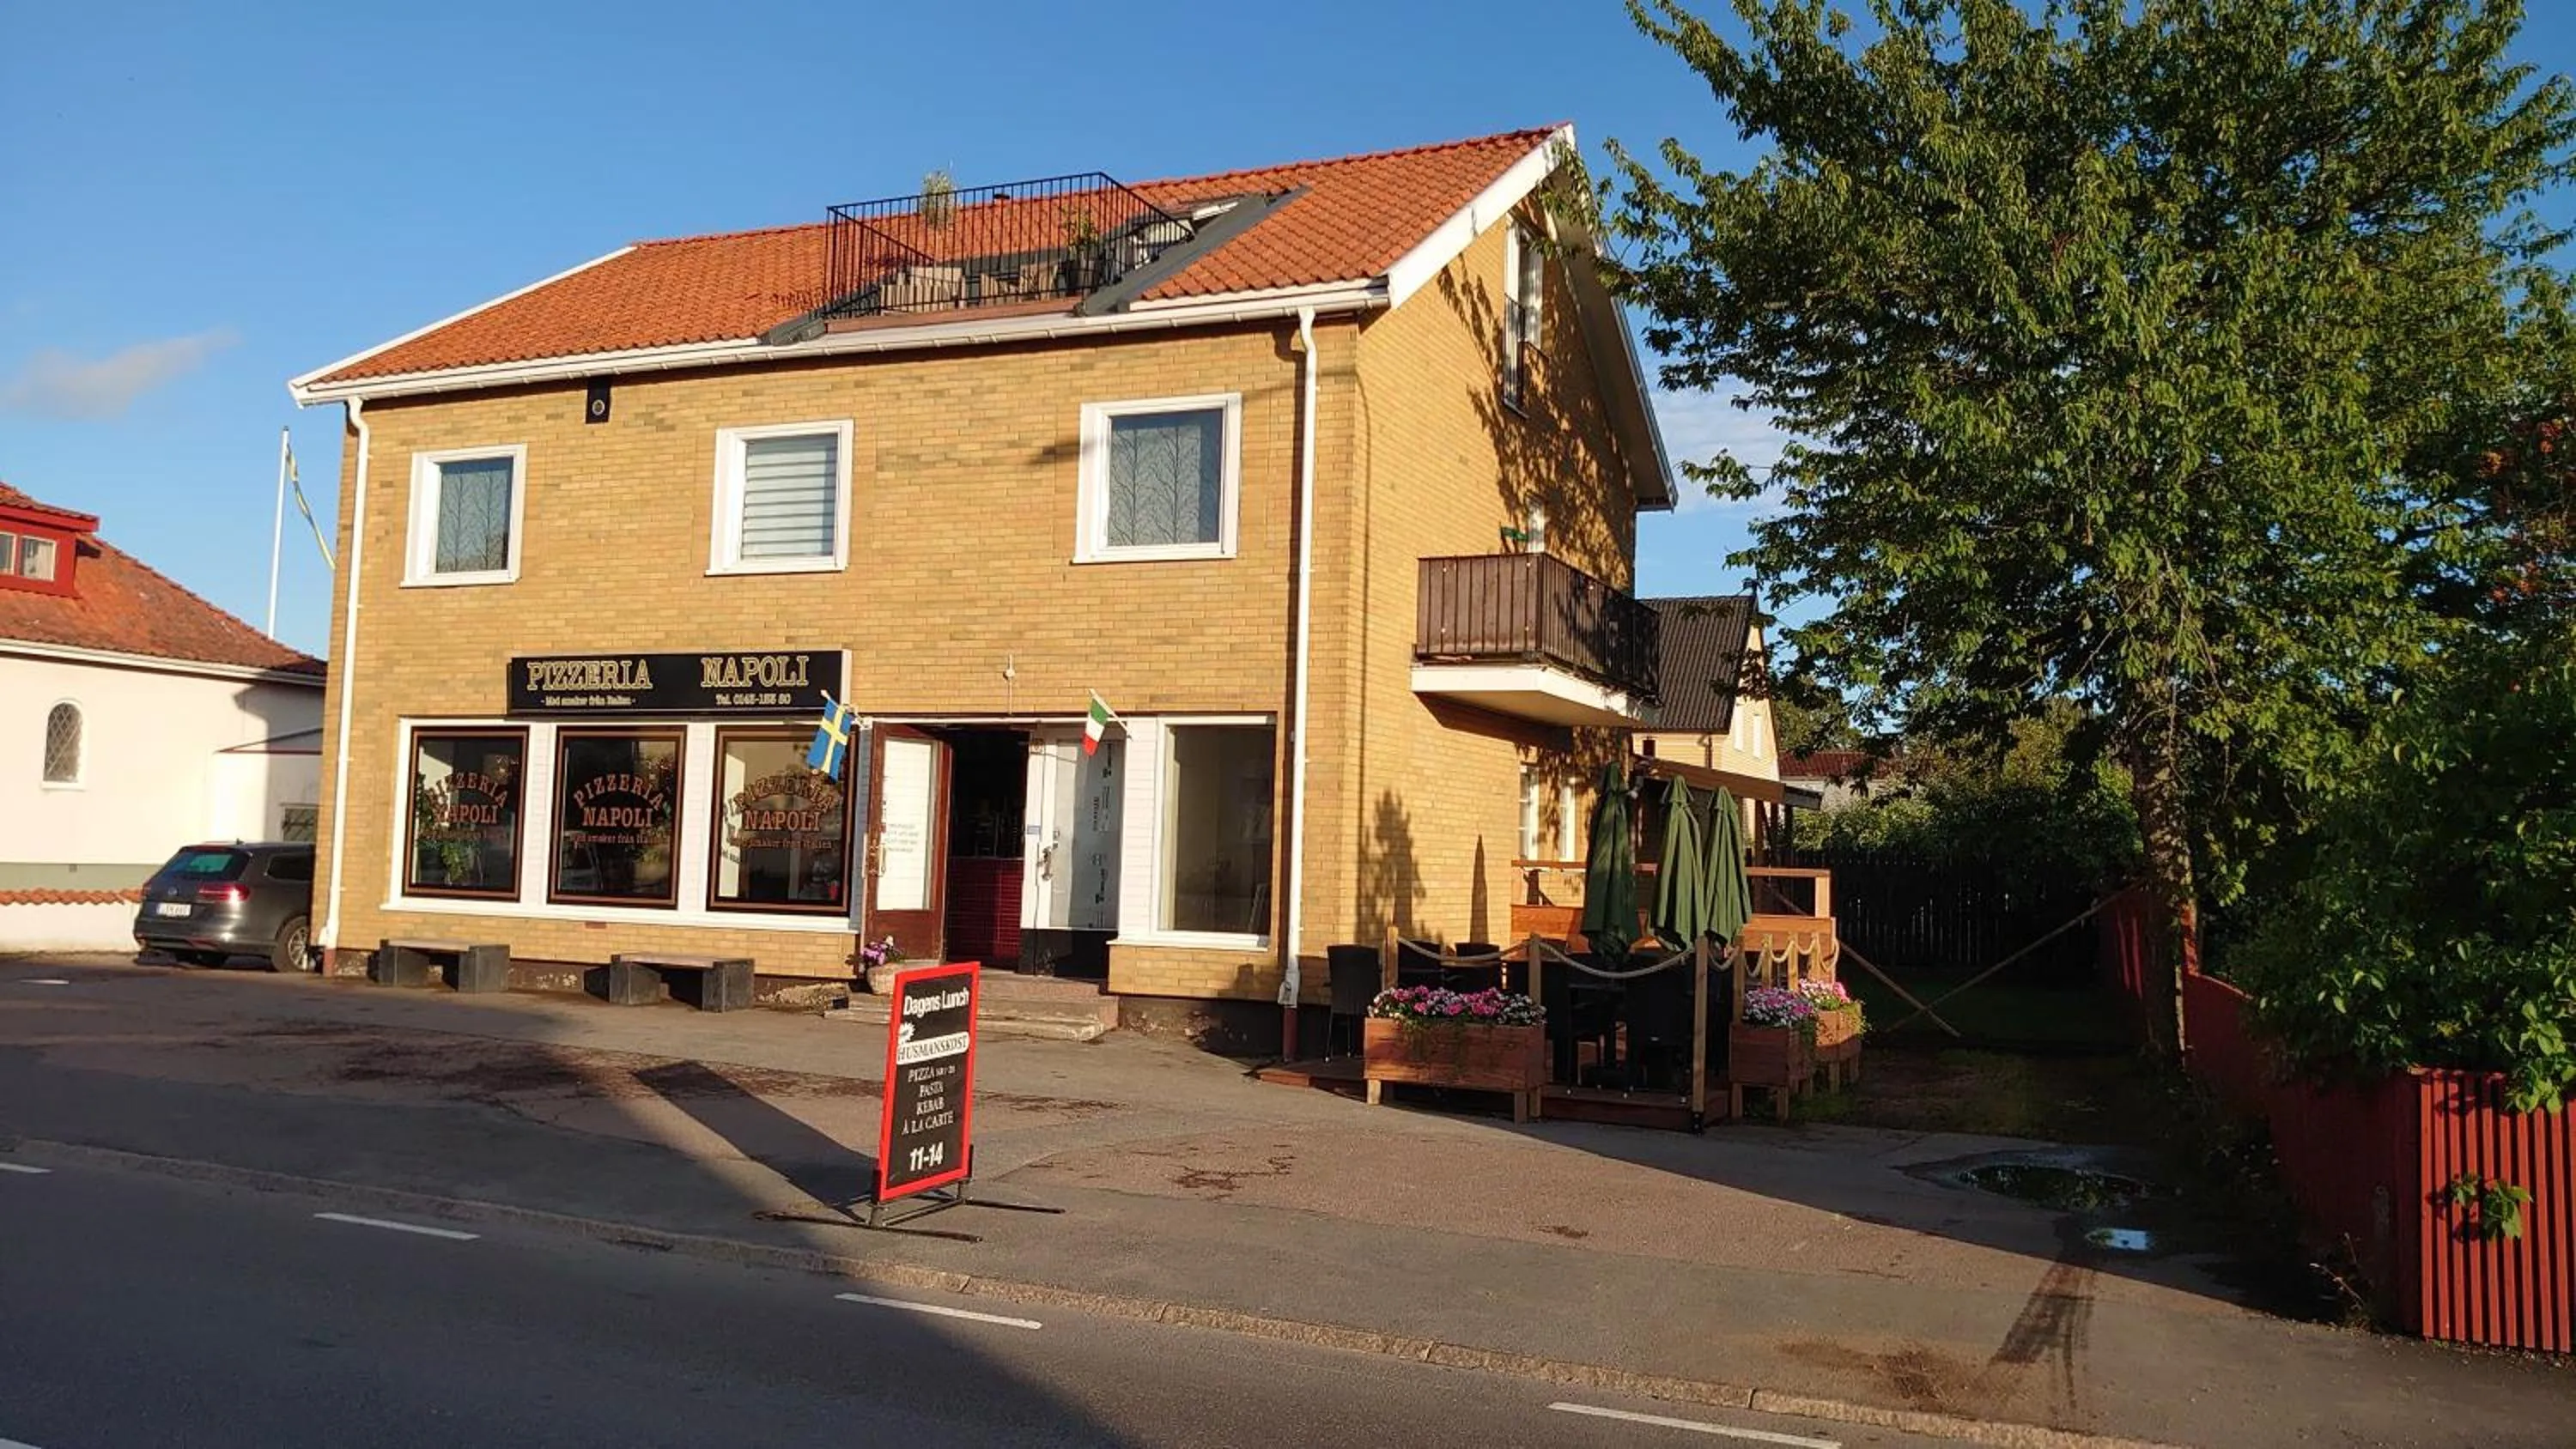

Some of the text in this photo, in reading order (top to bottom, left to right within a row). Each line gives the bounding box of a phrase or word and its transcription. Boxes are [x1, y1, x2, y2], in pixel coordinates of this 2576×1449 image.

[526, 655, 810, 691] PIZZERIA NAPOLI
[573, 773, 665, 811] PIZZERIA
[582, 806, 653, 828] NAPOLI
[743, 809, 821, 832] NAPOLI
[903, 986, 969, 1018] Dagens Lunch
[897, 1034, 968, 1062] HUSMANSKOST
[908, 1066, 935, 1082] PIZZA
[910, 1141, 944, 1172] 11-14
